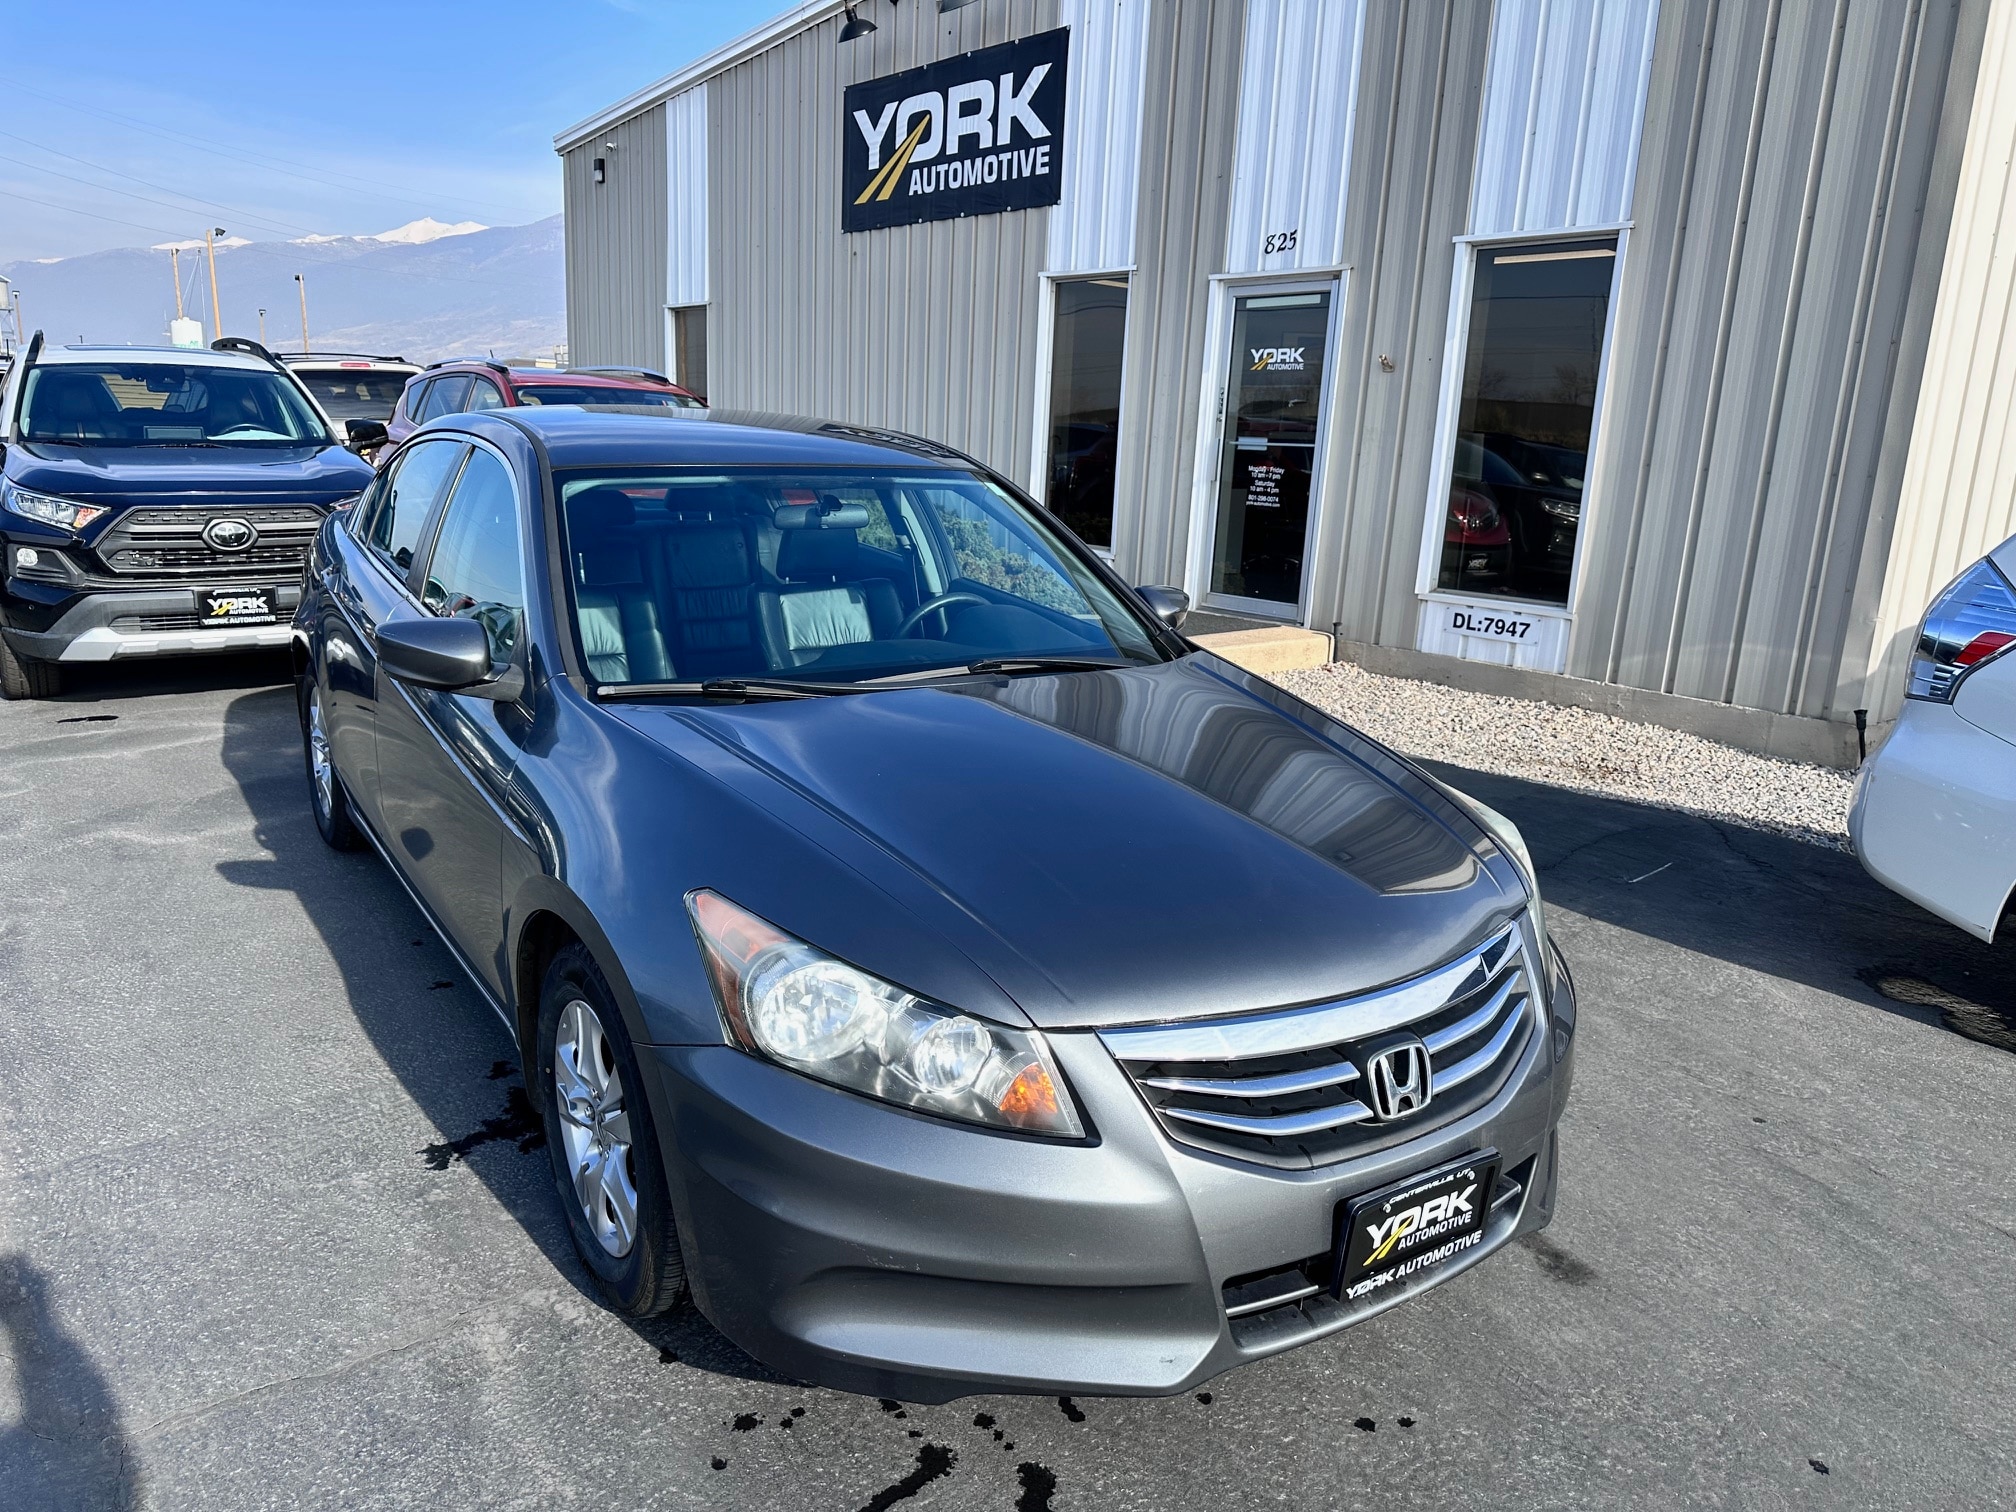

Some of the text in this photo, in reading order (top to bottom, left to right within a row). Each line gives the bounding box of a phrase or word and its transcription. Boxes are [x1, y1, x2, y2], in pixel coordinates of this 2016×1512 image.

[853, 63, 1053, 170] YORK
[908, 144, 1050, 196] AUTOMOTIVE
[1264, 229, 1298, 255] 825
[1250, 347, 1305, 363] YORK
[1266, 363, 1304, 371] AUTOMOTIVE
[207, 597, 268, 610] YORK
[230, 616, 276, 624] AUTOMOTIVE
[1452, 612, 1531, 638] DL:7947
[1456, 1167, 1471, 1178] UT
[1366, 1184, 1478, 1250] YORK
[1397, 1210, 1473, 1251] AUTOMOTIVE
[1345, 1230, 1482, 1299] YORK AUTOMOTIVE
